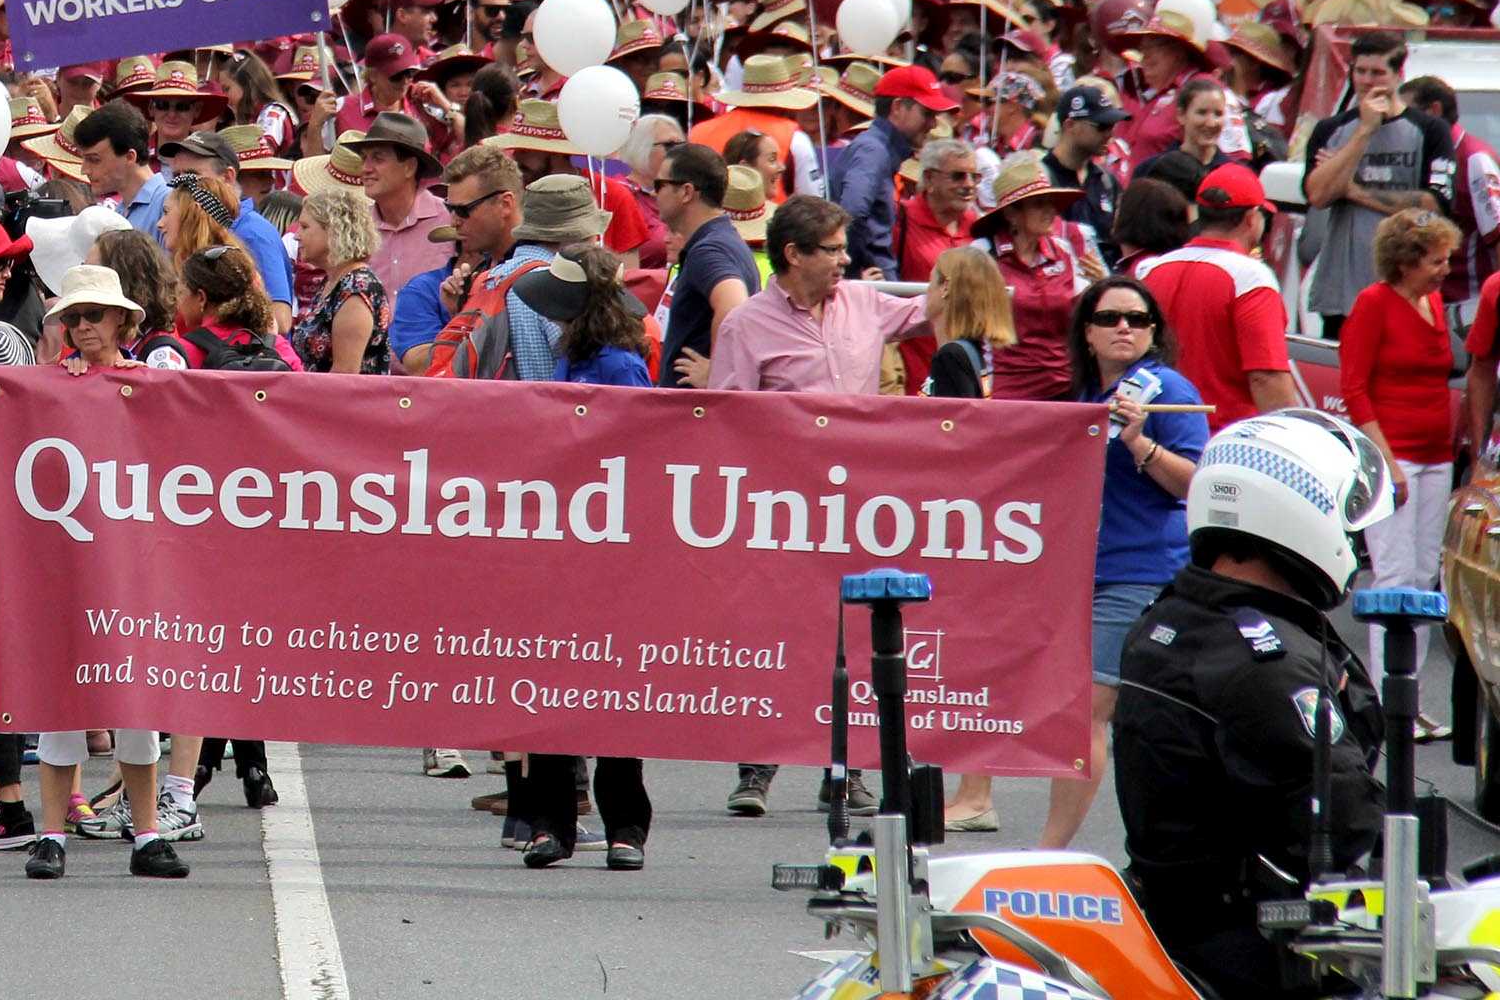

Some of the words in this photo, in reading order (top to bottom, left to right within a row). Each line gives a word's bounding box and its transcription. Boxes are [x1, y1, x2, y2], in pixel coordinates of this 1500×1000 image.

[14, 437, 631, 544] Queensland
[665, 463, 1045, 564] Unions
[1213, 483, 1238, 497] SHOEI
[85, 608, 226, 653] Working
[240, 619, 274, 647] to
[287, 621, 421, 654] achieve
[433, 627, 625, 669] industrial,
[638, 636, 788, 673] political
[75, 655, 135, 686] and
[146, 663, 244, 694] social
[251, 665, 374, 703] justice
[381, 671, 440, 709] for
[450, 677, 497, 706] all
[509, 677, 785, 719] Queenslanders.
[910, 709, 936, 730] of
[941, 710, 1025, 735] Unions
[983, 887, 1125, 926] POLICE
